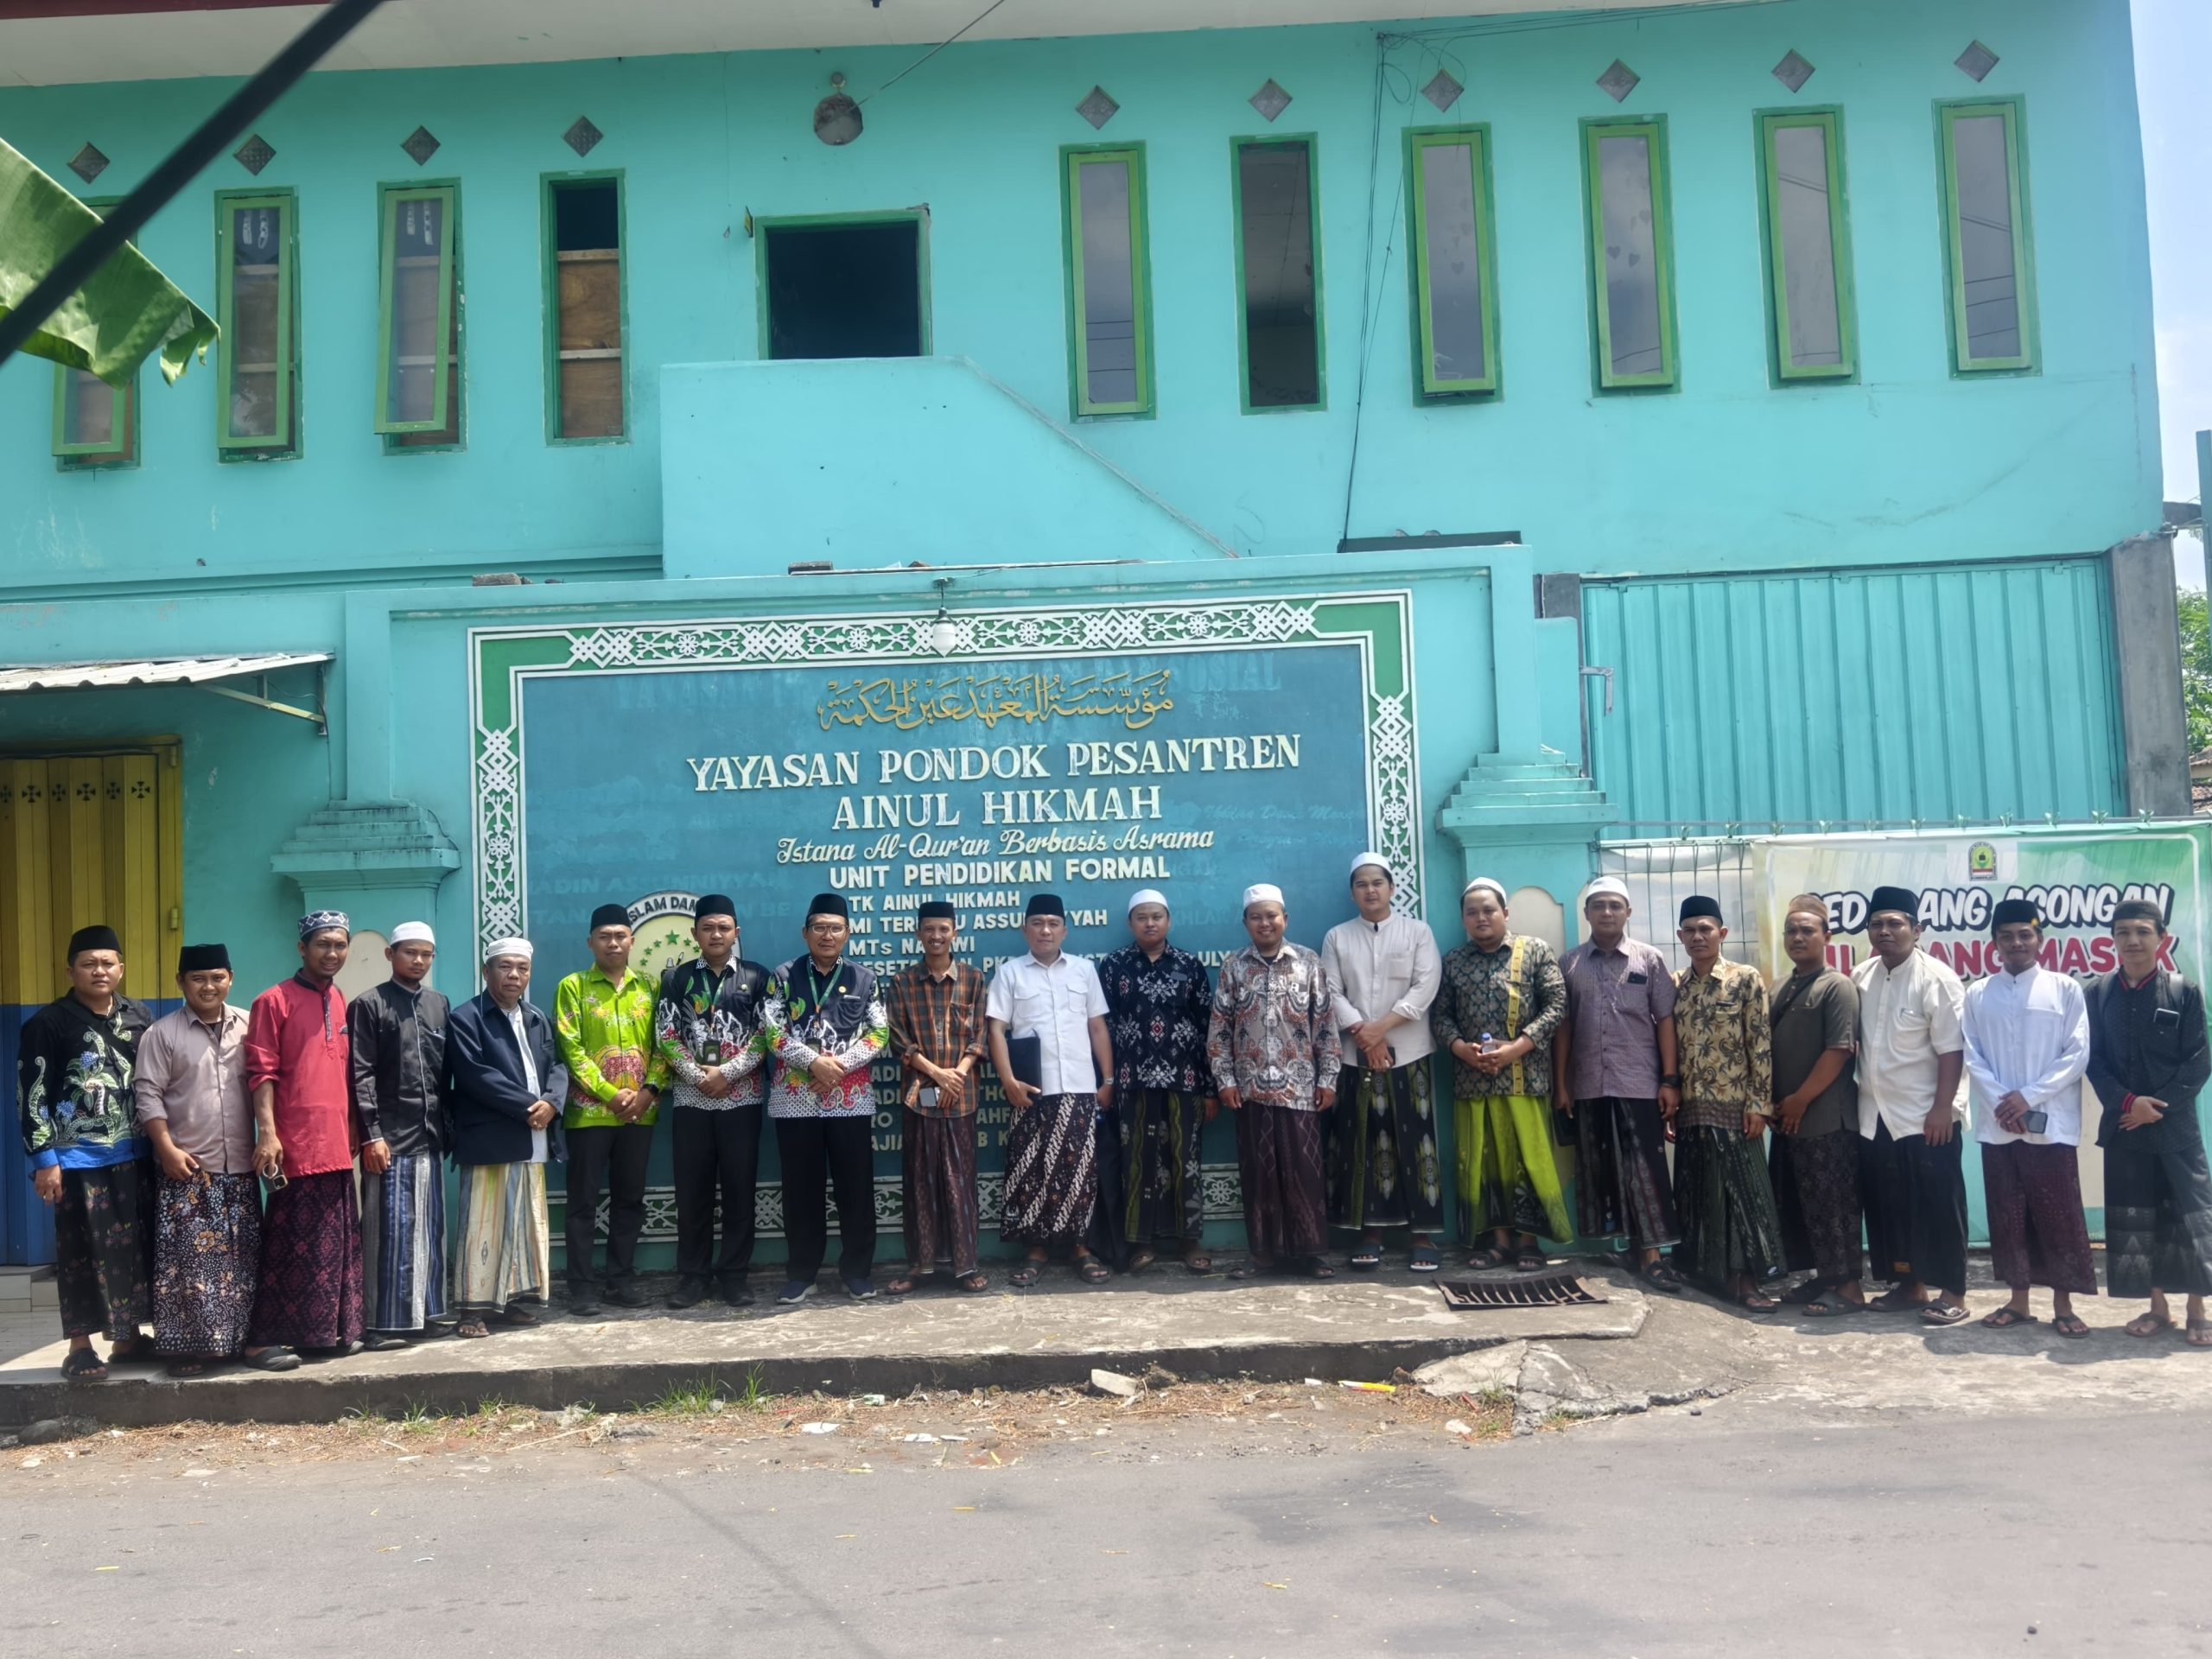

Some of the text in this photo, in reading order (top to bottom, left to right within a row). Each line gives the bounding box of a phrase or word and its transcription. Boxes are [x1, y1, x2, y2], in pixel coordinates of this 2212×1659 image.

[687, 734, 1300, 791] YAYASAN PONDOK PESANTREN
[832, 793, 961, 830] AINUL
[982, 785, 1162, 825] HIKMAH
[776, 836, 857, 864] Istana
[864, 832, 991, 861] Al-Qur'an
[999, 827, 1109, 857] Berbasis
[1112, 824, 1214, 852] Asrama
[830, 865, 890, 890] UNIT
[904, 860, 1052, 887] PENDIDIKAN
[1065, 855, 1171, 881] FORMAL
[628, 897, 668, 925] SLAM
[849, 895, 874, 912] TK
[945, 891, 1020, 909] HIKMAH
[849, 918, 872, 934] MI
[849, 938, 893, 957] MTs
[2039, 935, 2177, 978] MASK
